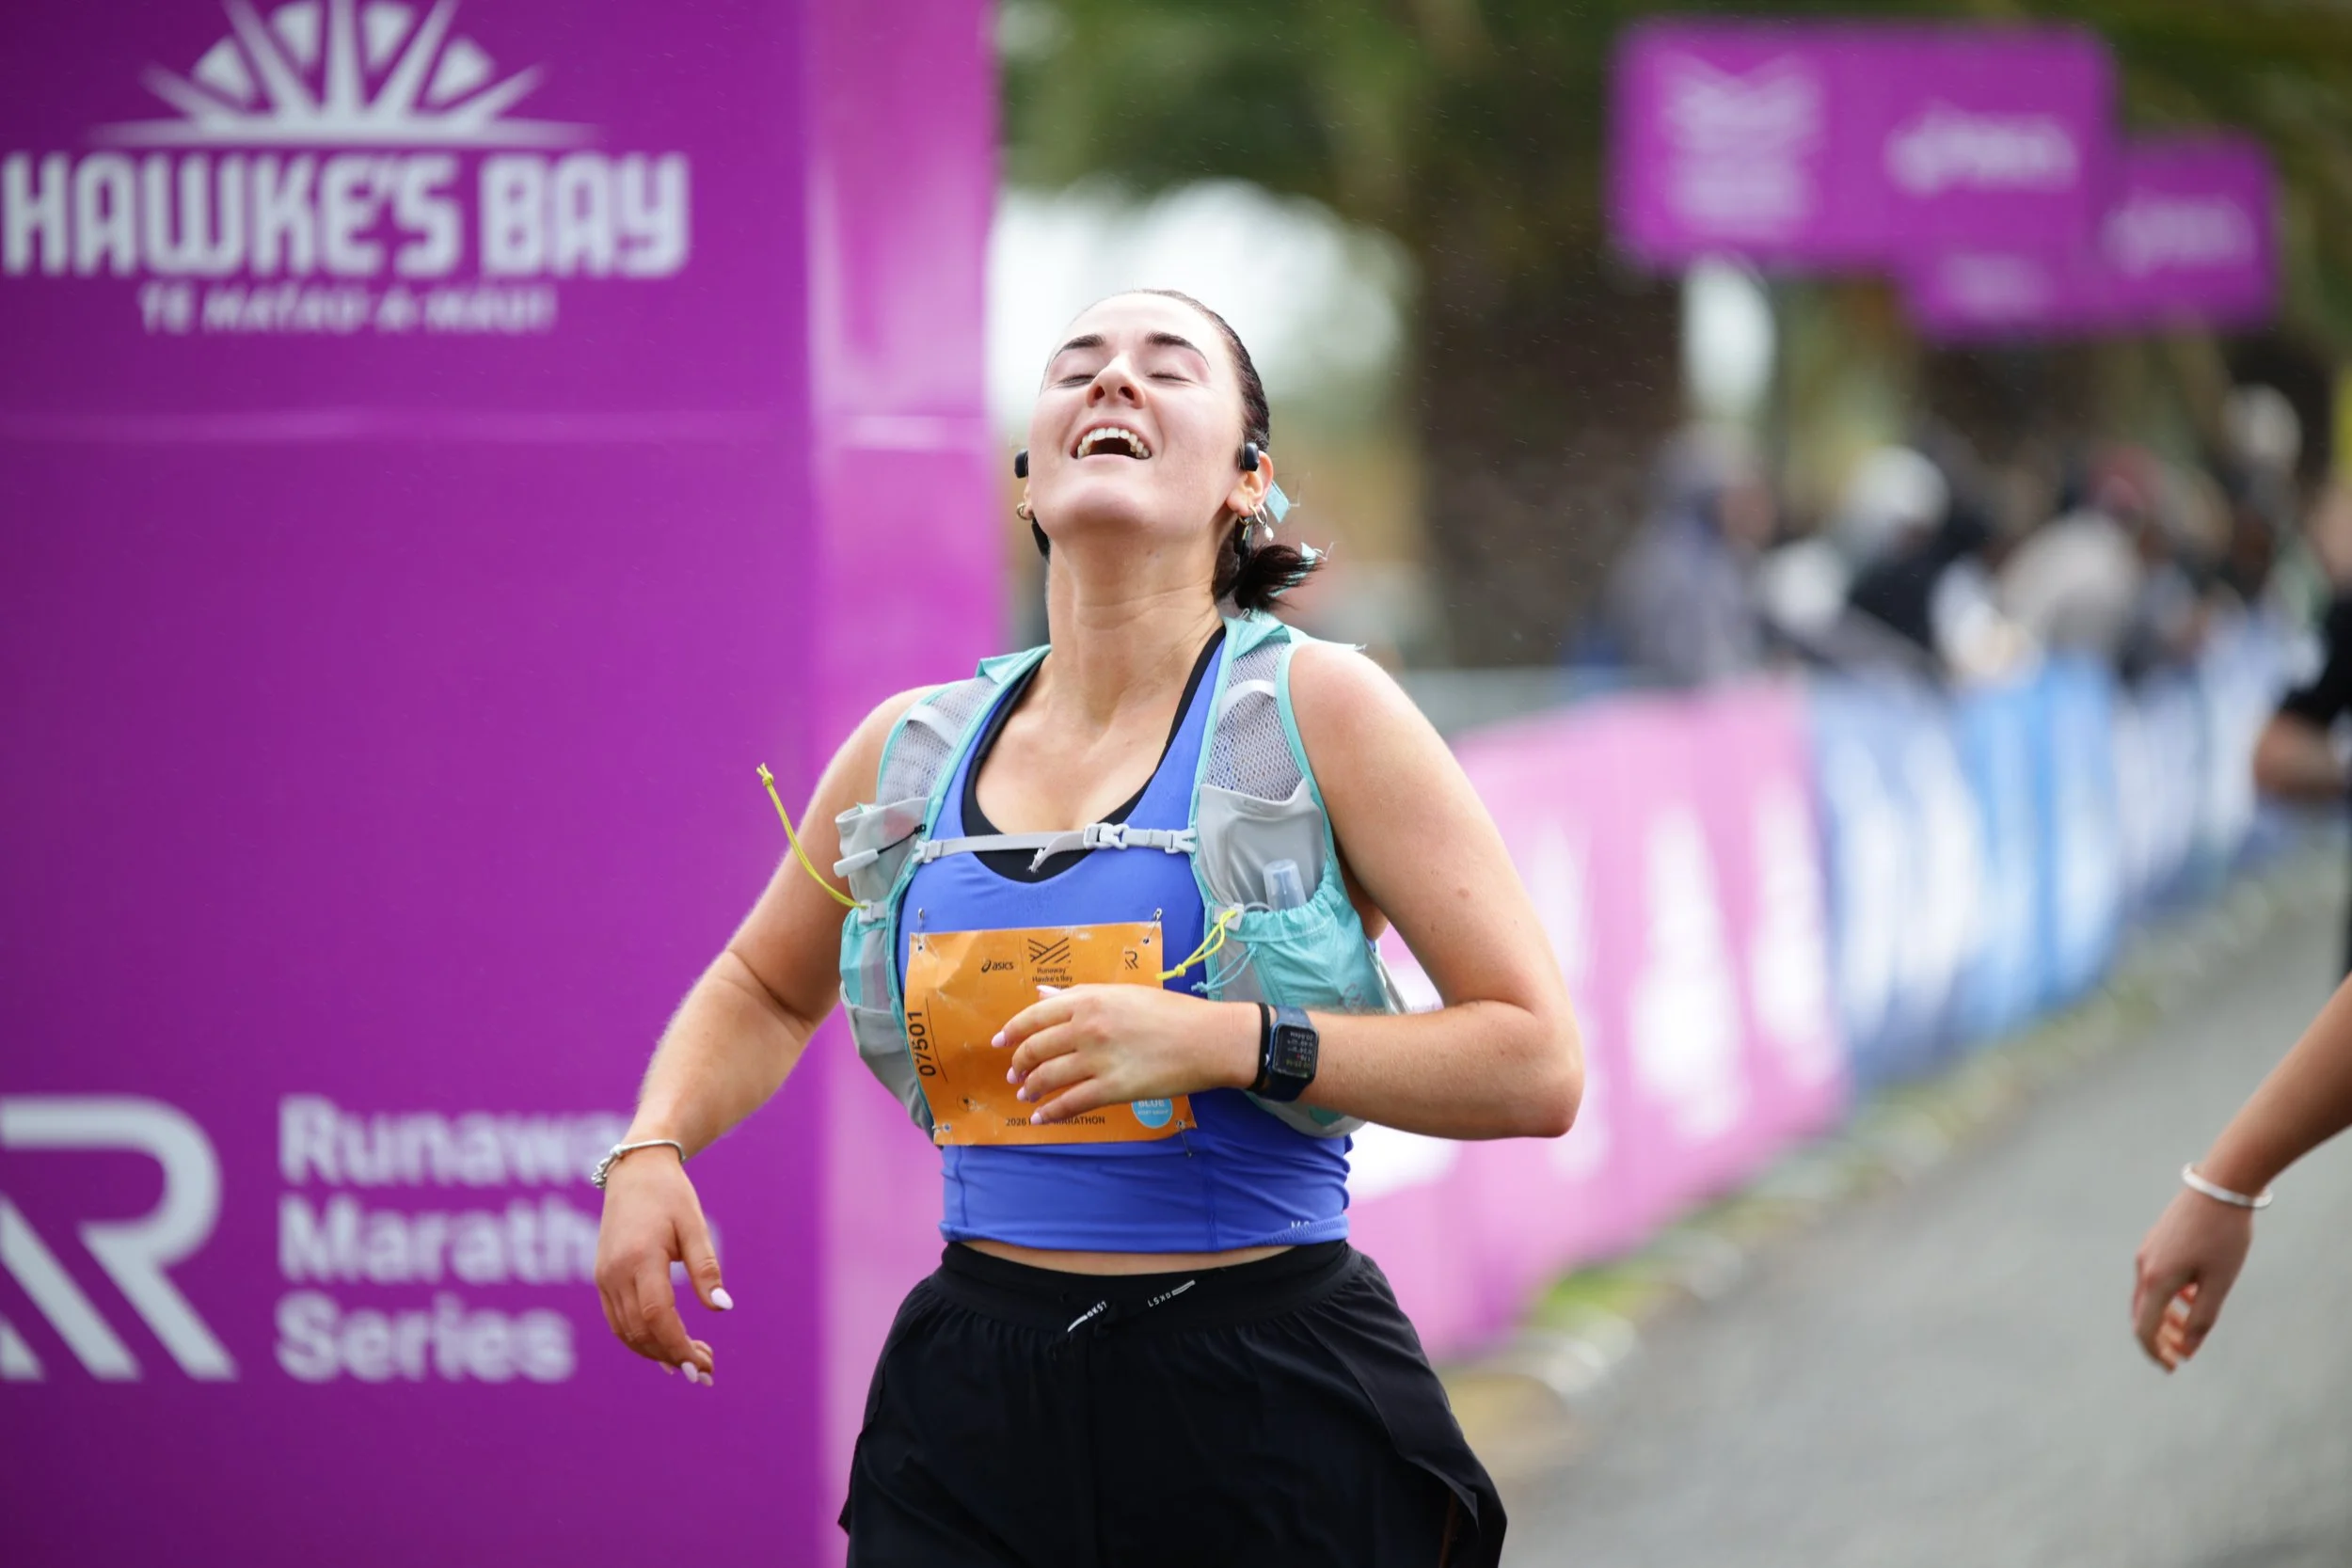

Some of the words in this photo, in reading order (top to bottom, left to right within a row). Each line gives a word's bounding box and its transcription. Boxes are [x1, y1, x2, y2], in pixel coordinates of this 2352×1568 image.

[1, 151, 462, 277] HAWKE'S
[478, 151, 690, 277] BAY
[992, 961, 1014, 971] asics
[907, 1011, 937, 1077] 07501
[278, 1096, 628, 1187] Runawa
[1006, 1117, 1026, 1127] 2026
[276, 1292, 577, 1383] Series
